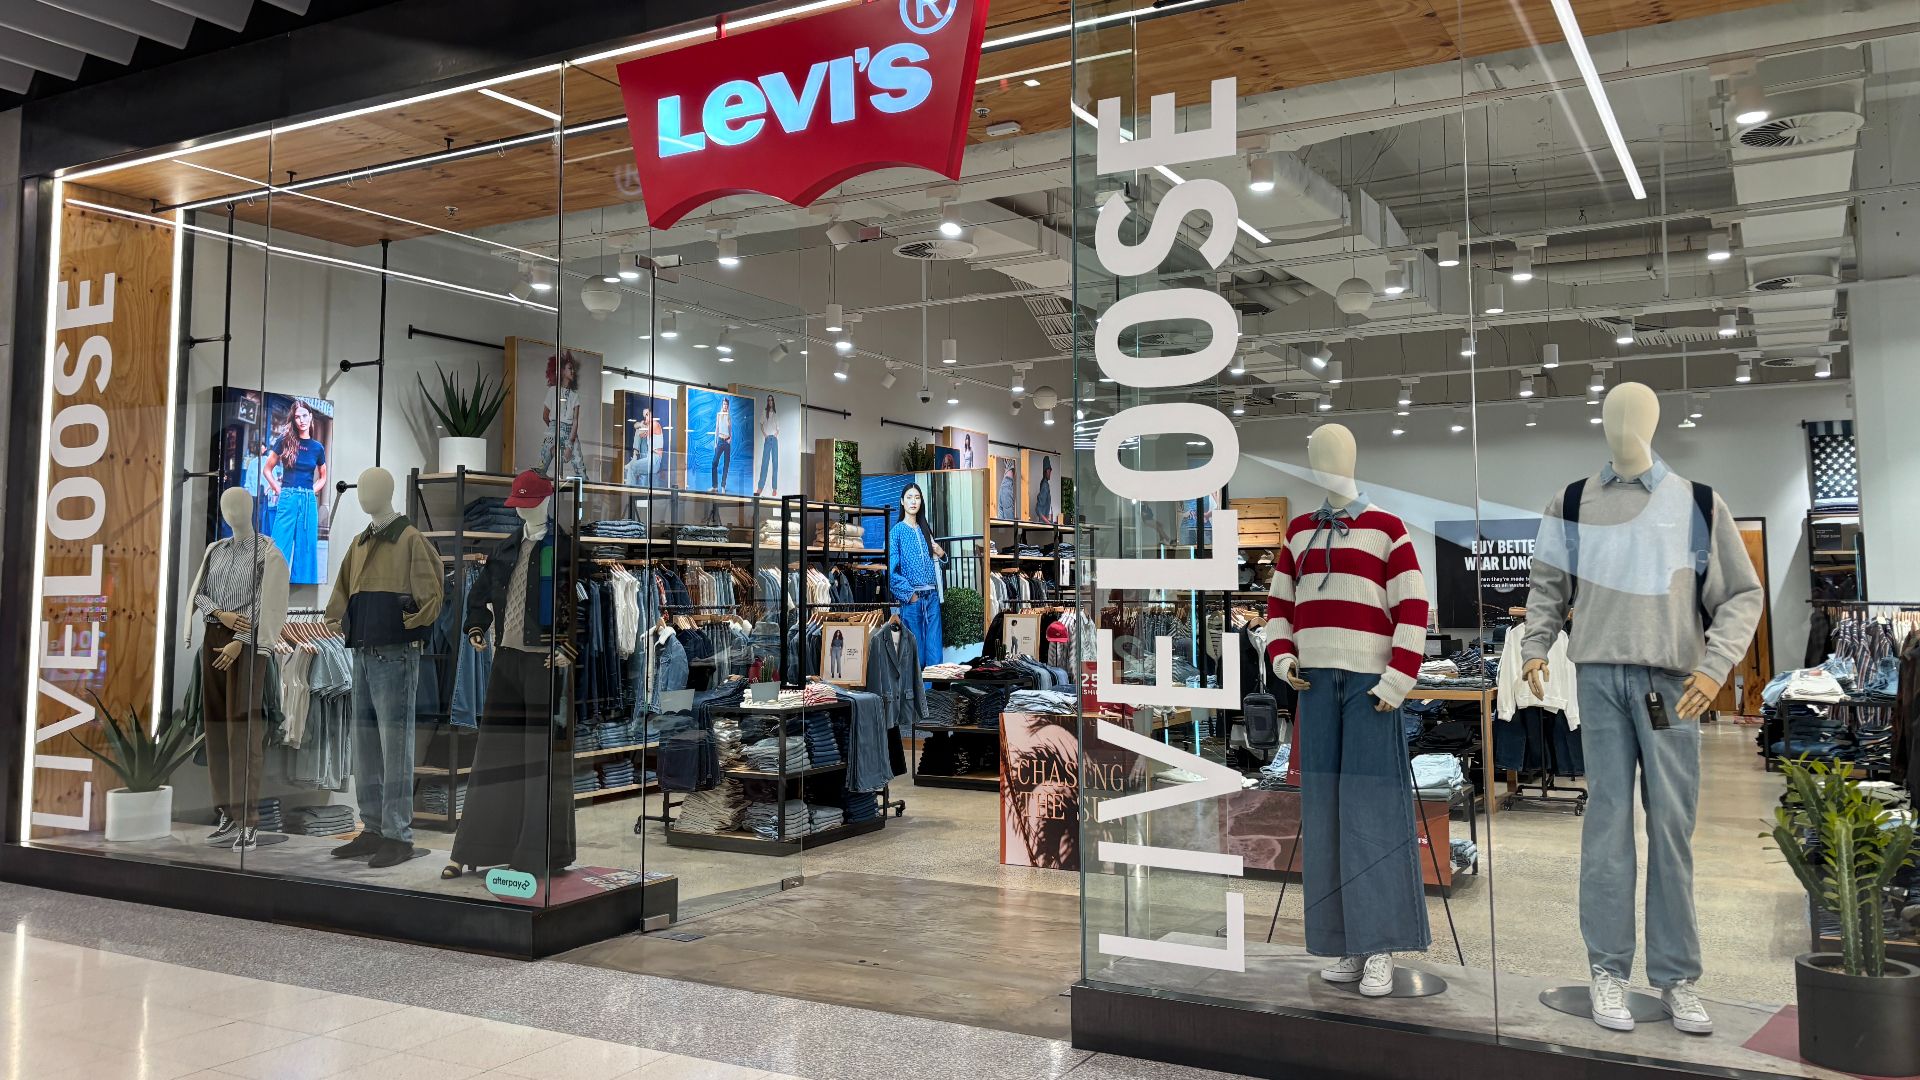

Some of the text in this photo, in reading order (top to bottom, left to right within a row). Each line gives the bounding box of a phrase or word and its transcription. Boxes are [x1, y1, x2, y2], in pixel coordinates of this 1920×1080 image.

[44, 272, 116, 597] LOOSE
[1094, 76, 1245, 972] LIVE LOOSE
[1497, 539, 1535, 554] BETTE
[32, 620, 99, 831] LIVE
[1017, 759, 1124, 792] CHASING
[1019, 791, 1065, 820] THE
[492, 876, 523, 891] afterpay
